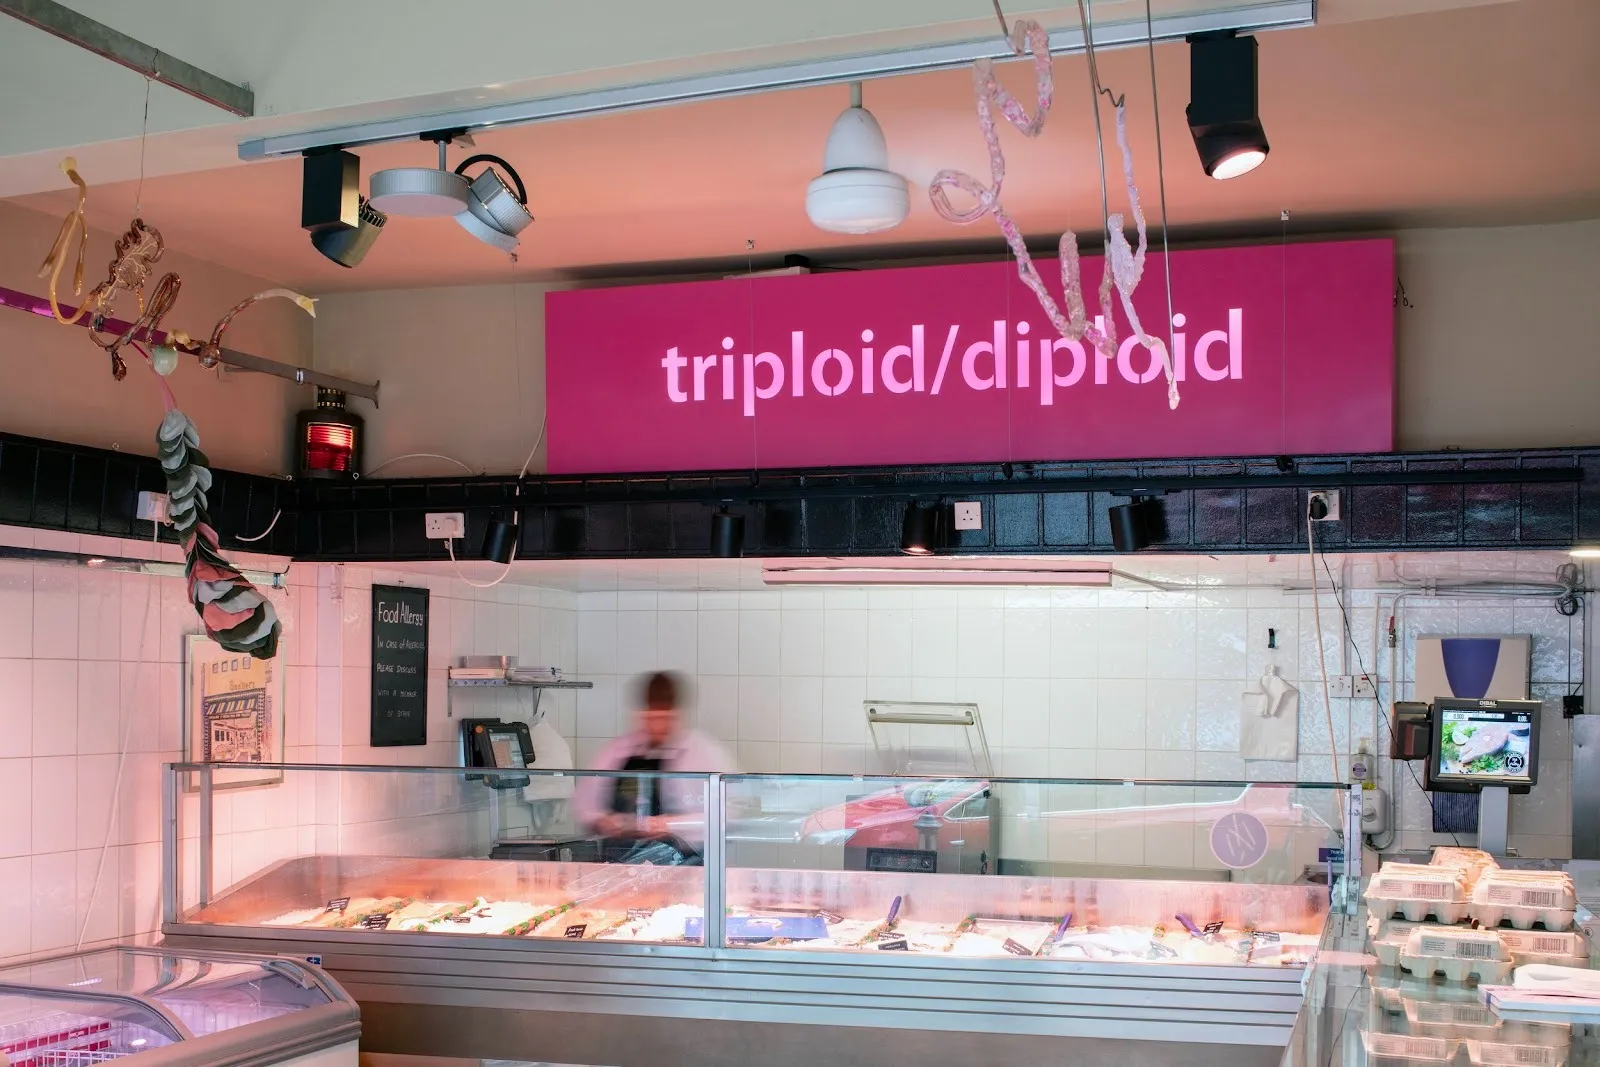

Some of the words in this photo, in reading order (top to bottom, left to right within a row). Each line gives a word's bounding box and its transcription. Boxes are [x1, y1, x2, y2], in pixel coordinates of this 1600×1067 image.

[662, 308, 1244, 416] triploid/diploid
[378, 601, 399, 624] Food
[400, 601, 424, 626] Allergy
[376, 662, 394, 673] PLEASE
